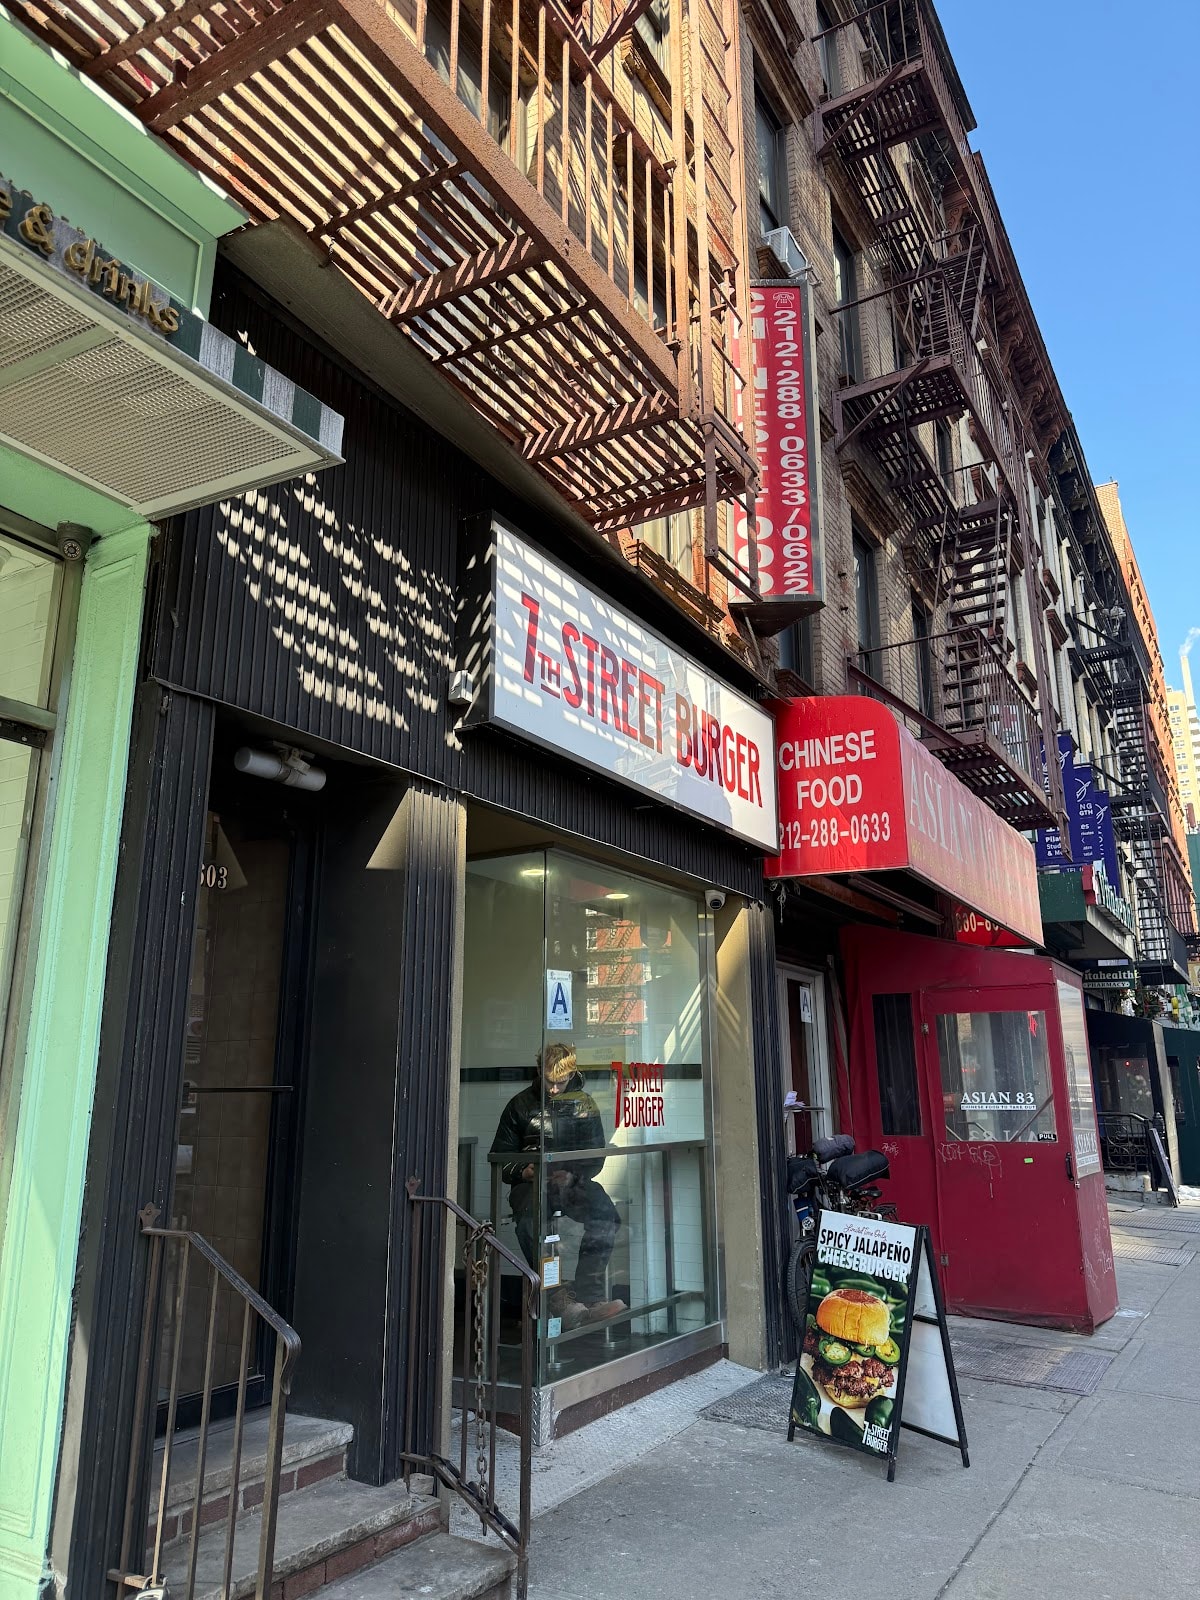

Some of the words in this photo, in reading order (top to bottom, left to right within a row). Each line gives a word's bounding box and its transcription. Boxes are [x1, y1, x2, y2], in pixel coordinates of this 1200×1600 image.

[18, 204, 56, 255] &
[63, 239, 180, 334] drinks
[562, 621, 666, 755] STREET
[675, 692, 763, 808] BURGER
[779, 730, 877, 771] CHINESE
[797, 774, 863, 810] FOOD
[909, 758, 976, 866] ASIAN
[779, 811, 891, 850] 212-288-0633
[1084, 968, 1135, 982] itahealth
[551, 982, 568, 1014] A
[802, 991, 810, 1013] A
[629, 1062, 665, 1093] STREET
[623, 1096, 665, 1128] BURGER
[961, 1091, 1011, 1105] ASIAN
[1016, 1091, 1035, 1105] 83
[820, 1228, 852, 1250] SPICY
[852, 1236, 911, 1264] JALAPEÑO
[817, 1246, 908, 1284] CHEESEBURGER
[866, 1435, 888, 1453] BURGER
[870, 1423, 890, 1441] STREET
